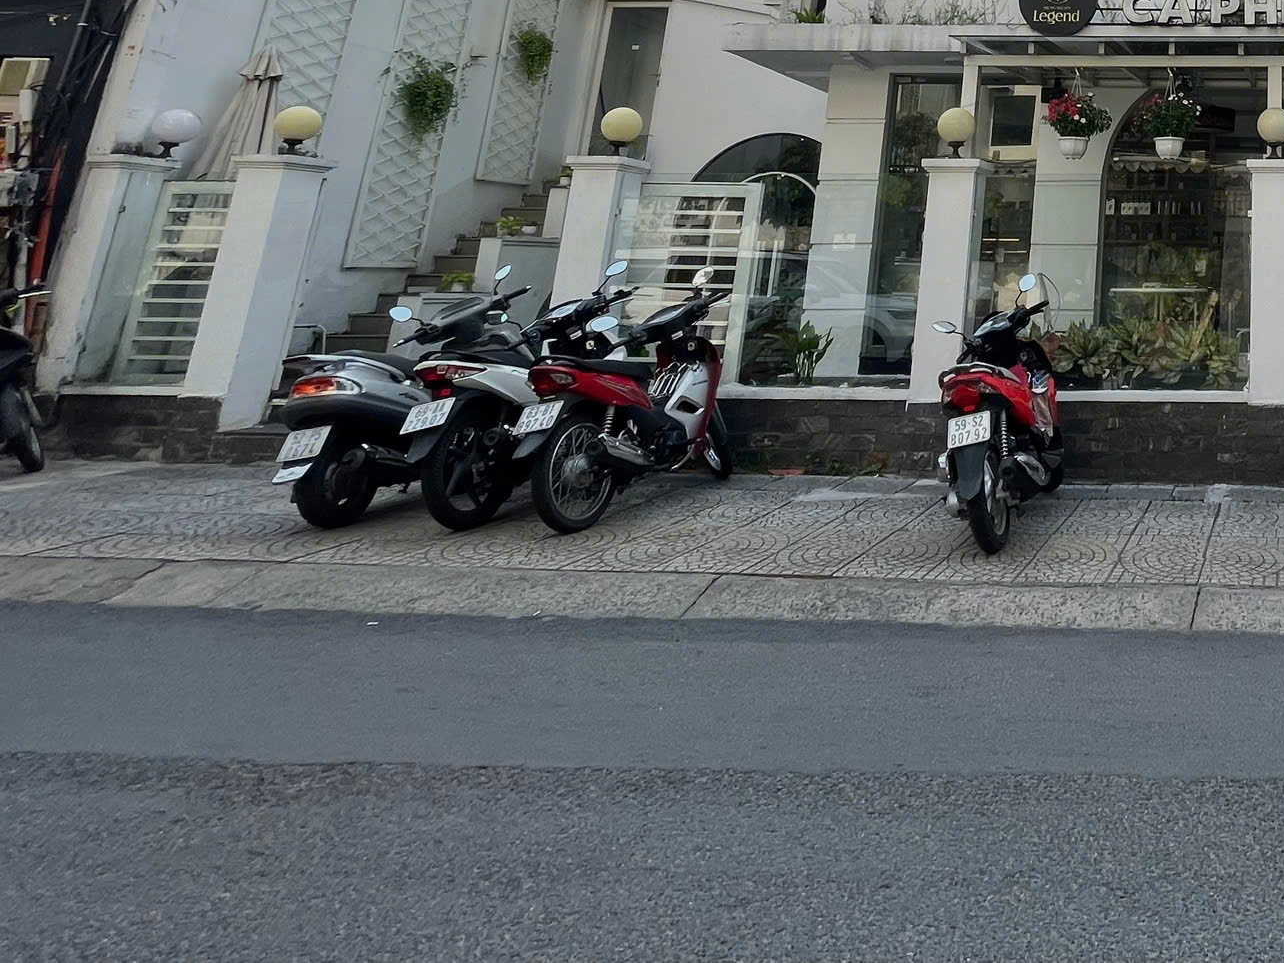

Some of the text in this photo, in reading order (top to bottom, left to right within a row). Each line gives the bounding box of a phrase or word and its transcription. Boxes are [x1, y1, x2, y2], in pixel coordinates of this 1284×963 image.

[1033, 9, 1080, 25] Legend
[954, 414, 984, 433] 59-S2
[950, 426, 988, 446] 807.92
